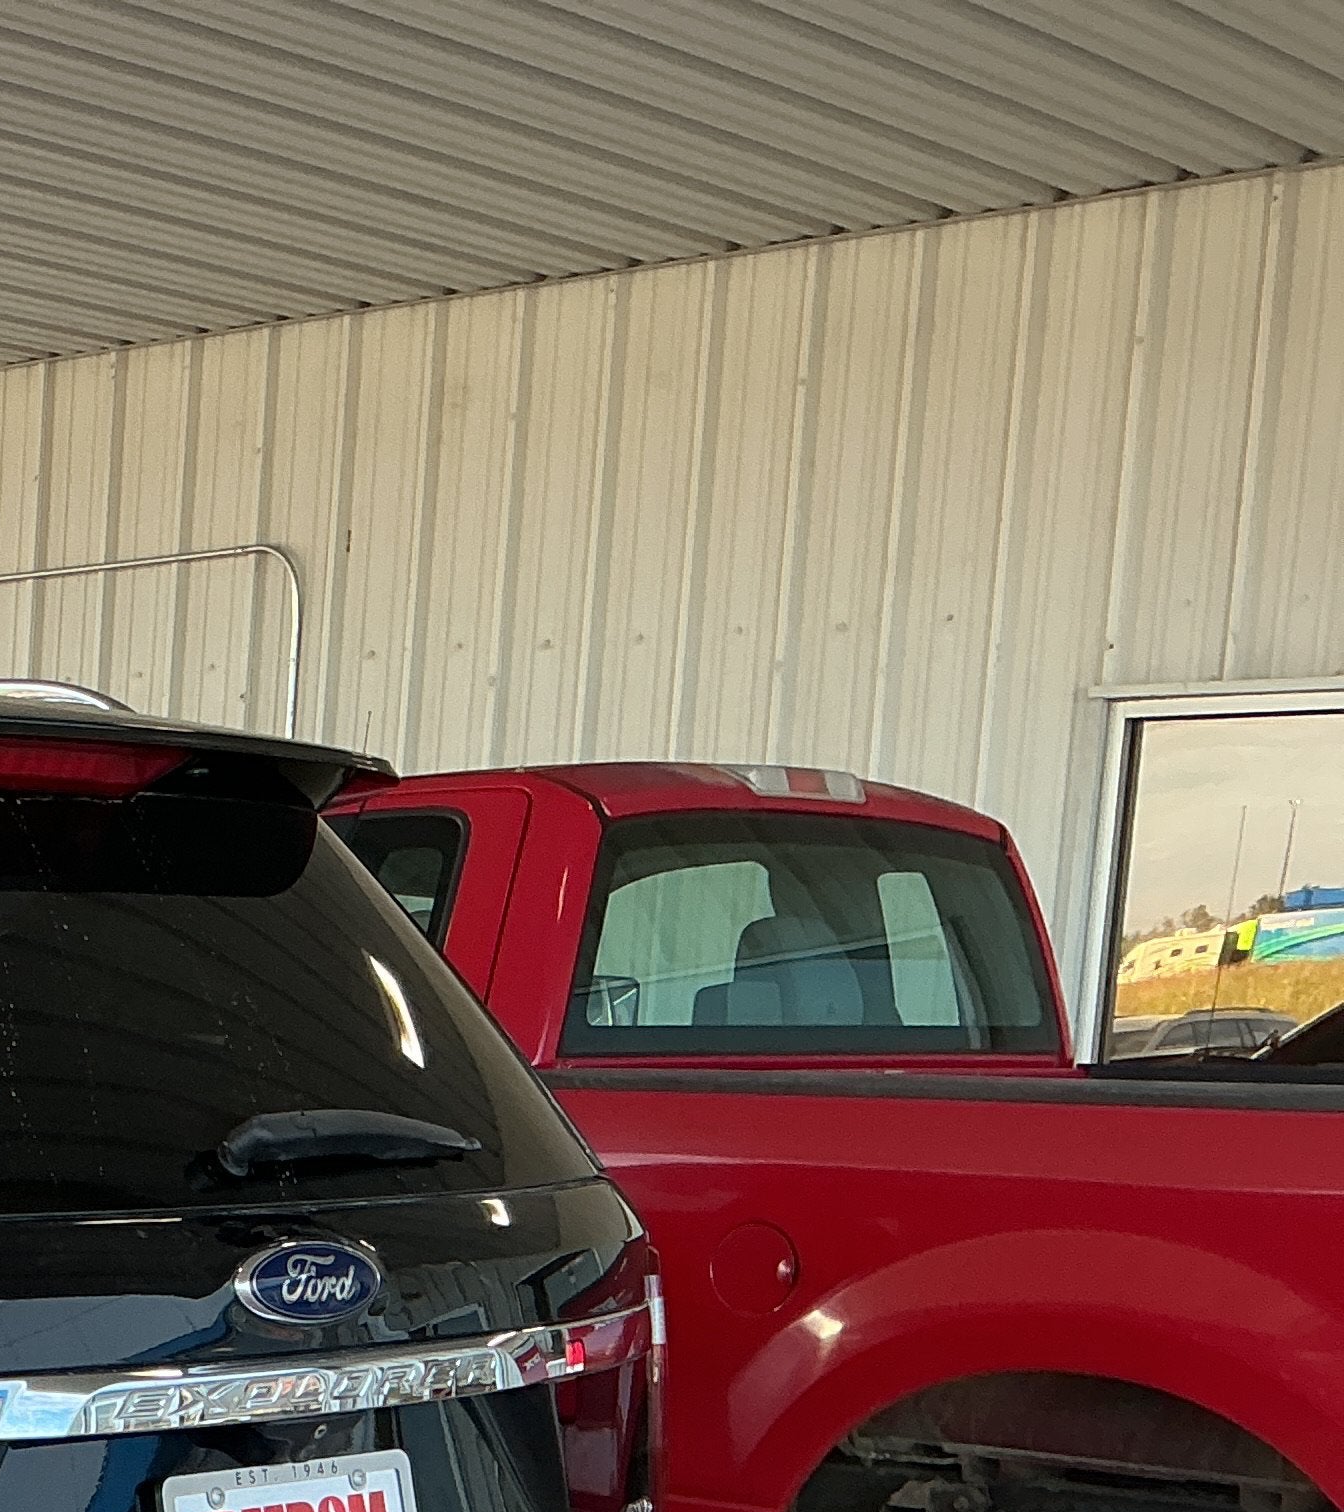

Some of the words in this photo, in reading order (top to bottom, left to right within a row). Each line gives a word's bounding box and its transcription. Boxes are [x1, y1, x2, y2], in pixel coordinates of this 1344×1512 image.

[281, 1253, 356, 1304] Ford
[235, 1468, 279, 1485] EST.
[291, 1460, 338, 1478] 1946
